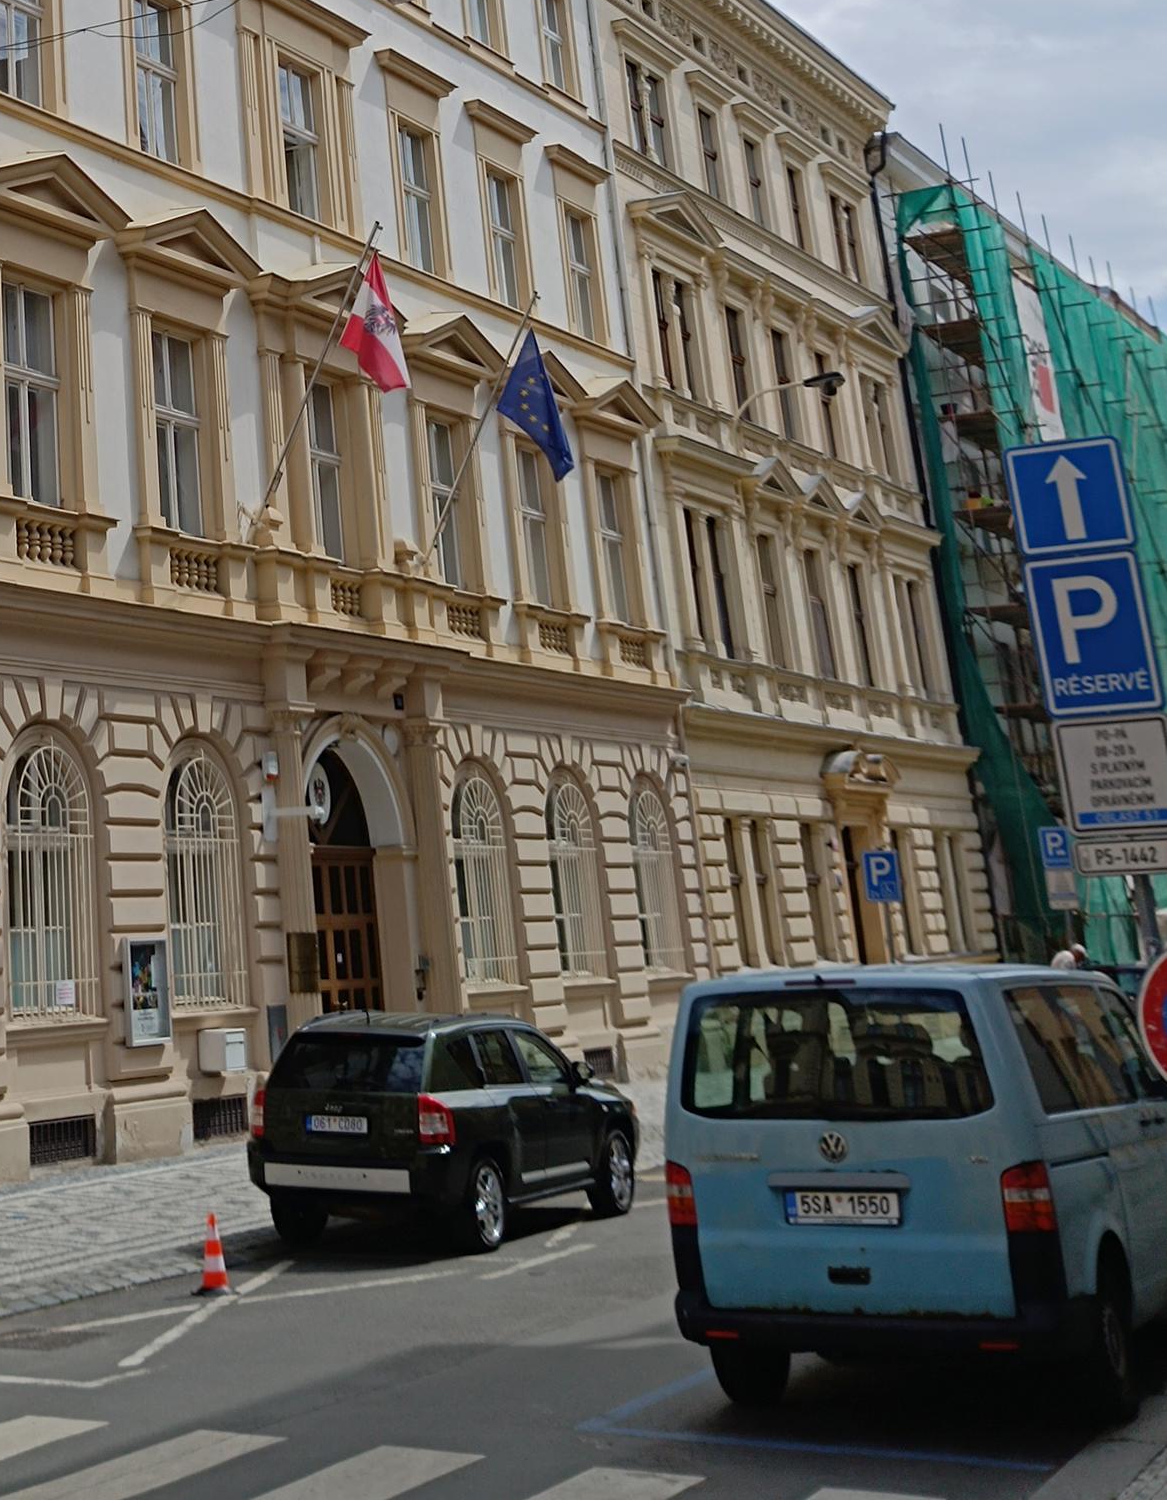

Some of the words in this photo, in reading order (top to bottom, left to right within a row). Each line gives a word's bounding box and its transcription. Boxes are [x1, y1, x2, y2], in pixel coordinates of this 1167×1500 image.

[1050, 575, 1118, 665] P
[1094, 846, 1159, 866] P5-1442
[869, 857, 891, 886] P
[800, 1195, 833, 1214] 5SA
[848, 1196, 890, 1215] 1550
